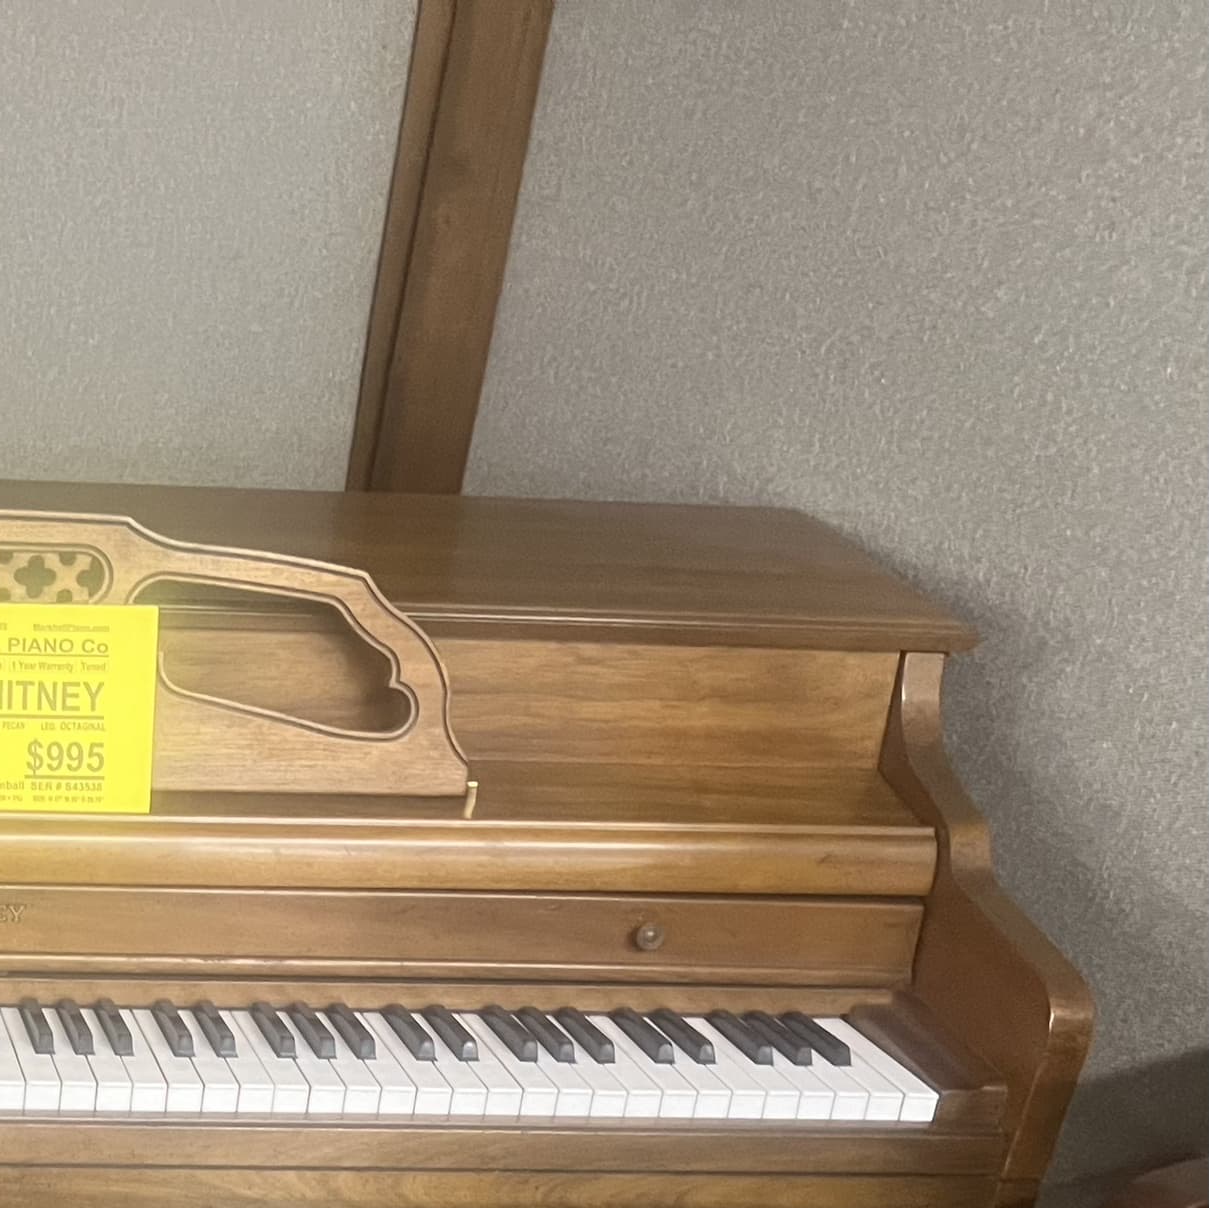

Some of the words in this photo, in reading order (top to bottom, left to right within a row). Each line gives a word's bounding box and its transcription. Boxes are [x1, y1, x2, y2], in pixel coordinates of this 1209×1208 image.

[7, 637, 74, 653] PIANO
[81, 638, 109, 654] Co
[26, 738, 104, 775] $995
